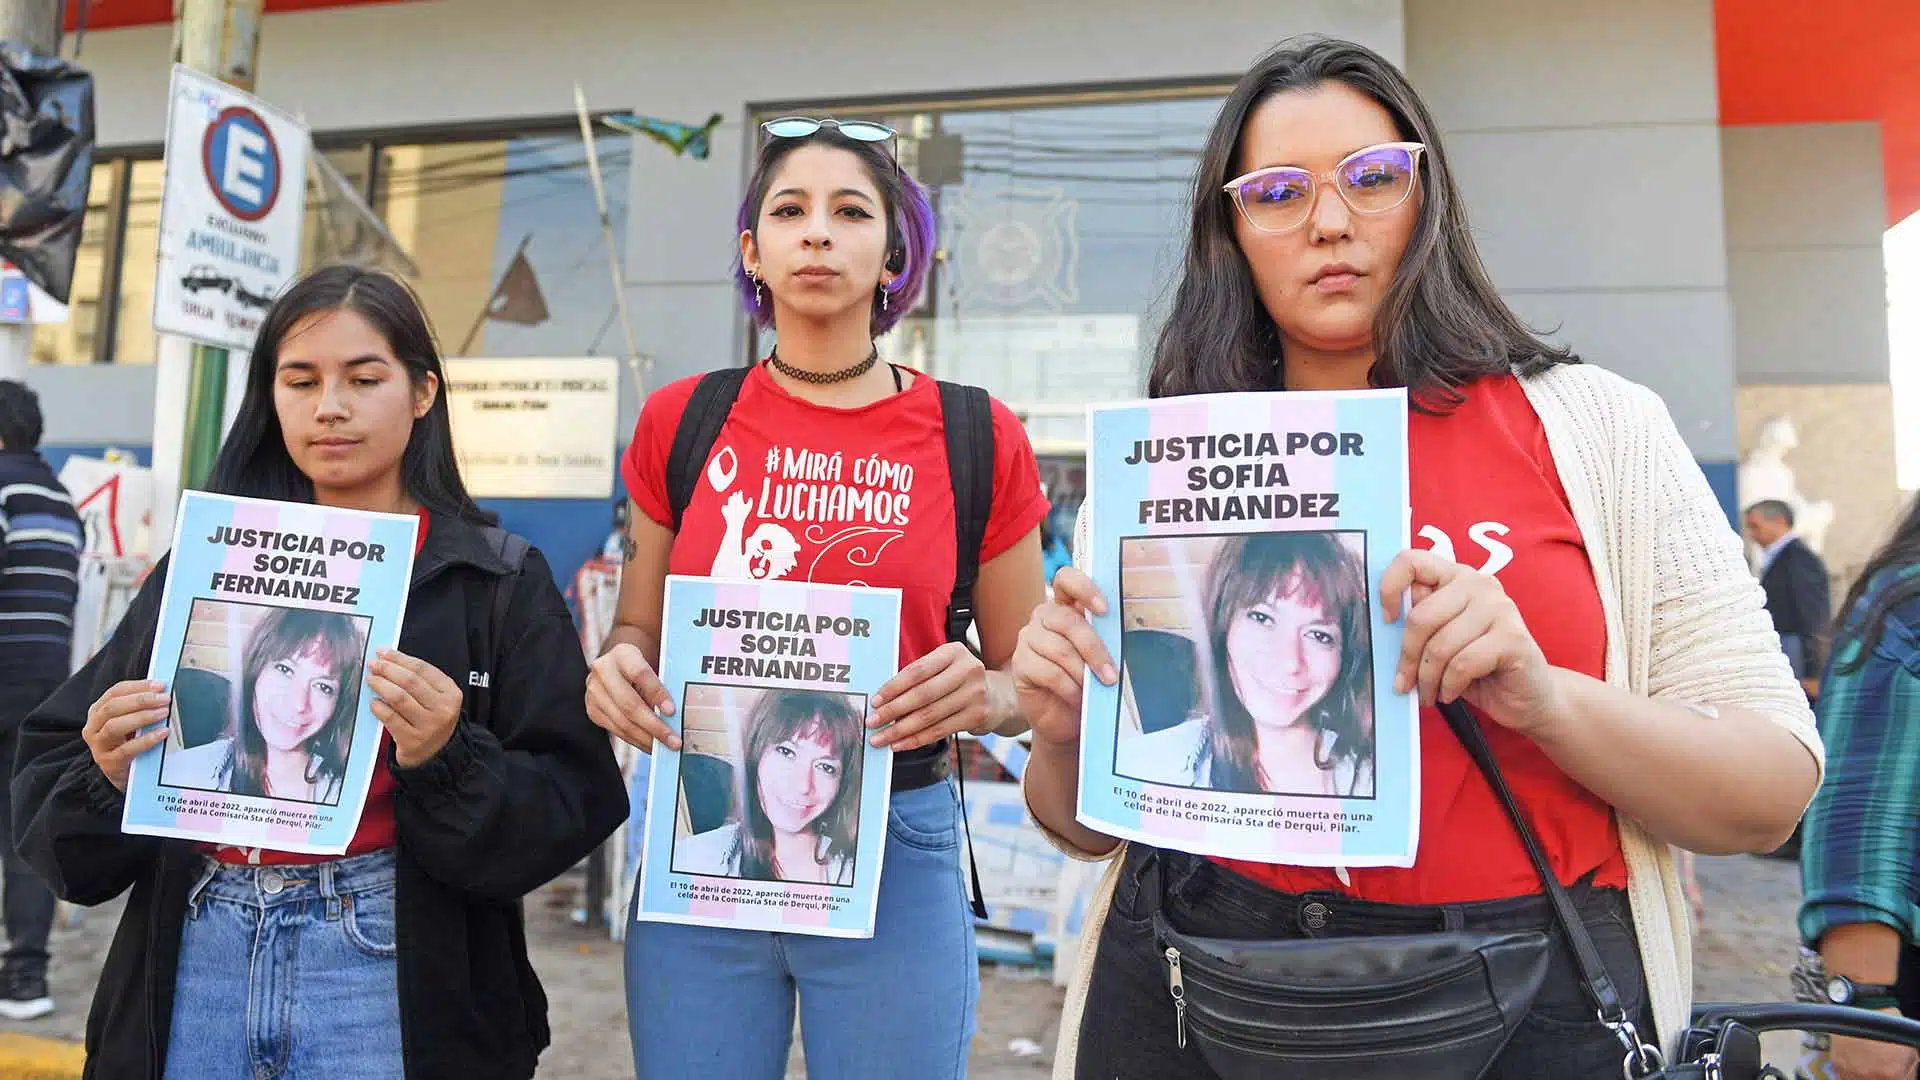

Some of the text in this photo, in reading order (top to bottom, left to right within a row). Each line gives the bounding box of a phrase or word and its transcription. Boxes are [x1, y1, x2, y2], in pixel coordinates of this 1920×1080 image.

[223, 122, 268, 207] E
[1124, 432, 1365, 465] JUSTICIA POR
[765, 444, 914, 493] #MIRÁ CÓMO
[1187, 456, 1290, 491] SOFÍA
[756, 476, 911, 526] LUCHAMOS
[1138, 489, 1340, 524] FERNÁNDEZ
[207, 526, 386, 562] JUSTICIA POR
[253, 553, 328, 578] SOFÍA
[210, 572, 361, 606] FERNÁNDEZ
[693, 608, 871, 638] JUSTICIA POR
[740, 632, 817, 657] SOFÍA
[701, 654, 851, 683] FERNÁNDEZ
[165, 805, 186, 813] celda
[167, 796, 176, 804] 10
[178, 797, 188, 805] de
[189, 799, 209, 807] abril
[210, 801, 220, 809] de
[279, 810, 307, 819] muerta
[1113, 786, 1373, 821] El 10 de abril de 2022, apareció muerta en una
[1124, 801, 1152, 814] celda
[1156, 807, 1169, 816] de
[1172, 808, 1182, 818] la
[1267, 820, 1281, 829] de
[678, 892, 698, 900] celda
[756, 890, 791, 898] apareció
[793, 893, 822, 901] muerta
[836, 896, 850, 904] una
